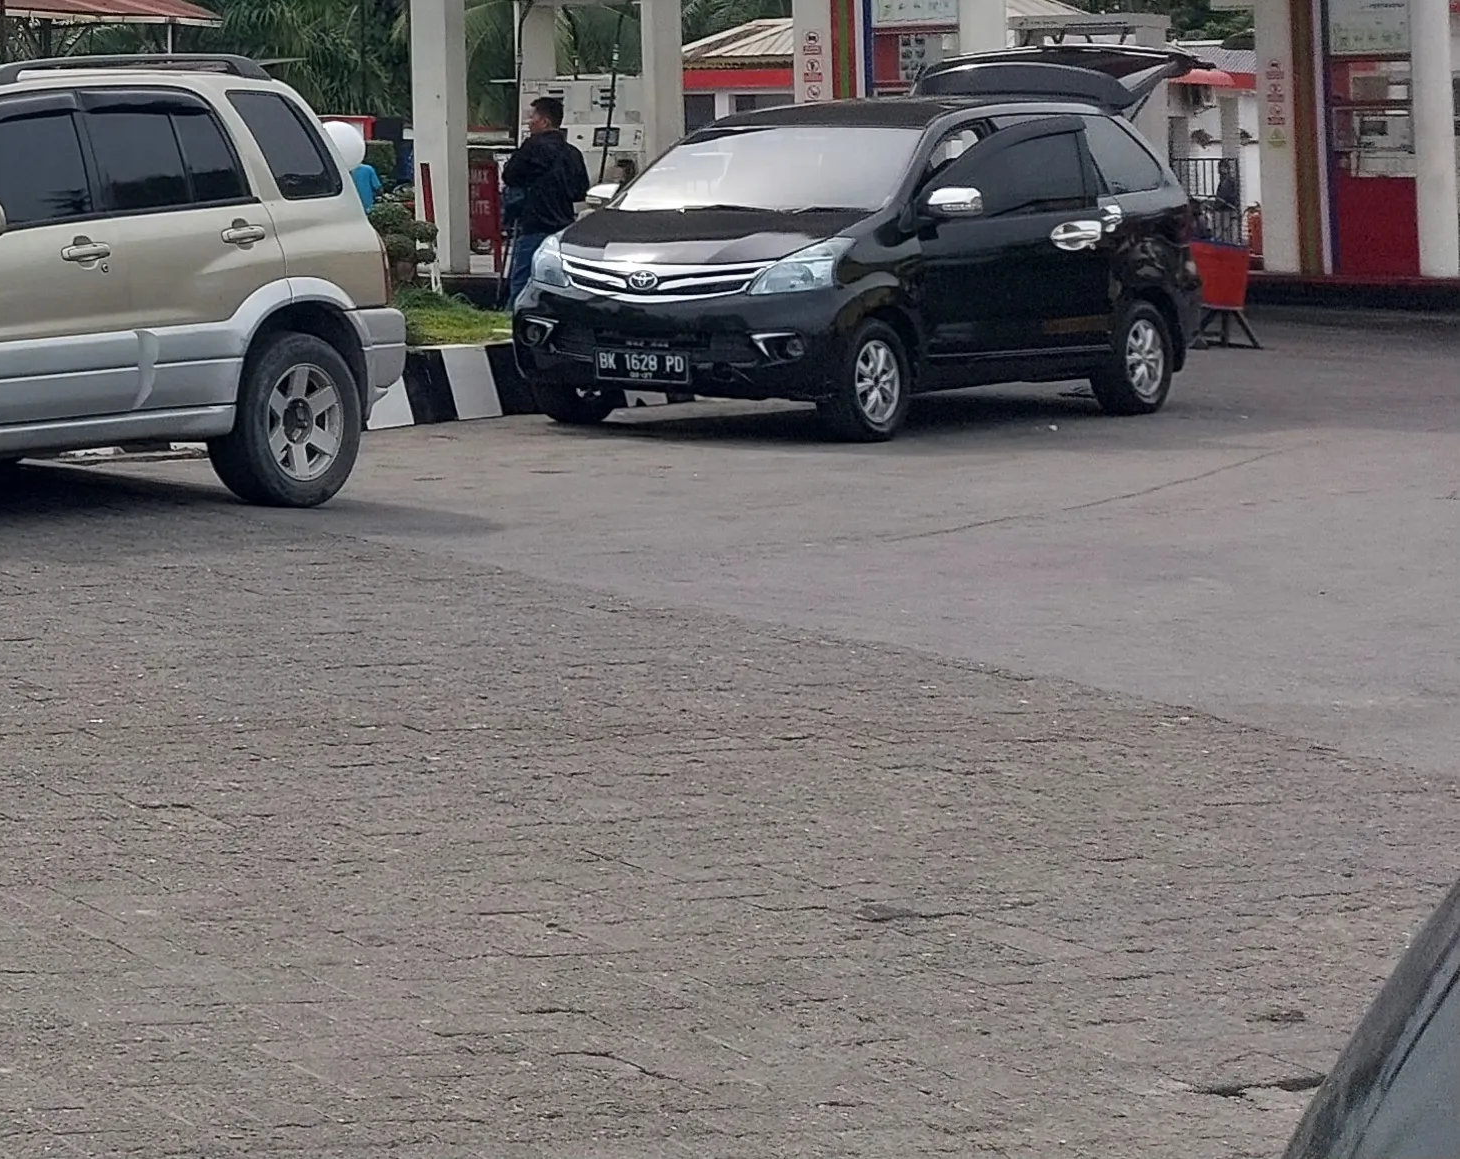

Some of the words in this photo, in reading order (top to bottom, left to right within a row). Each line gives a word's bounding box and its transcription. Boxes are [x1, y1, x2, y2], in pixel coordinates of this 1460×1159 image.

[598, 352, 617, 370] BK
[624, 353, 658, 371] 1628
[665, 355, 684, 373] PD
